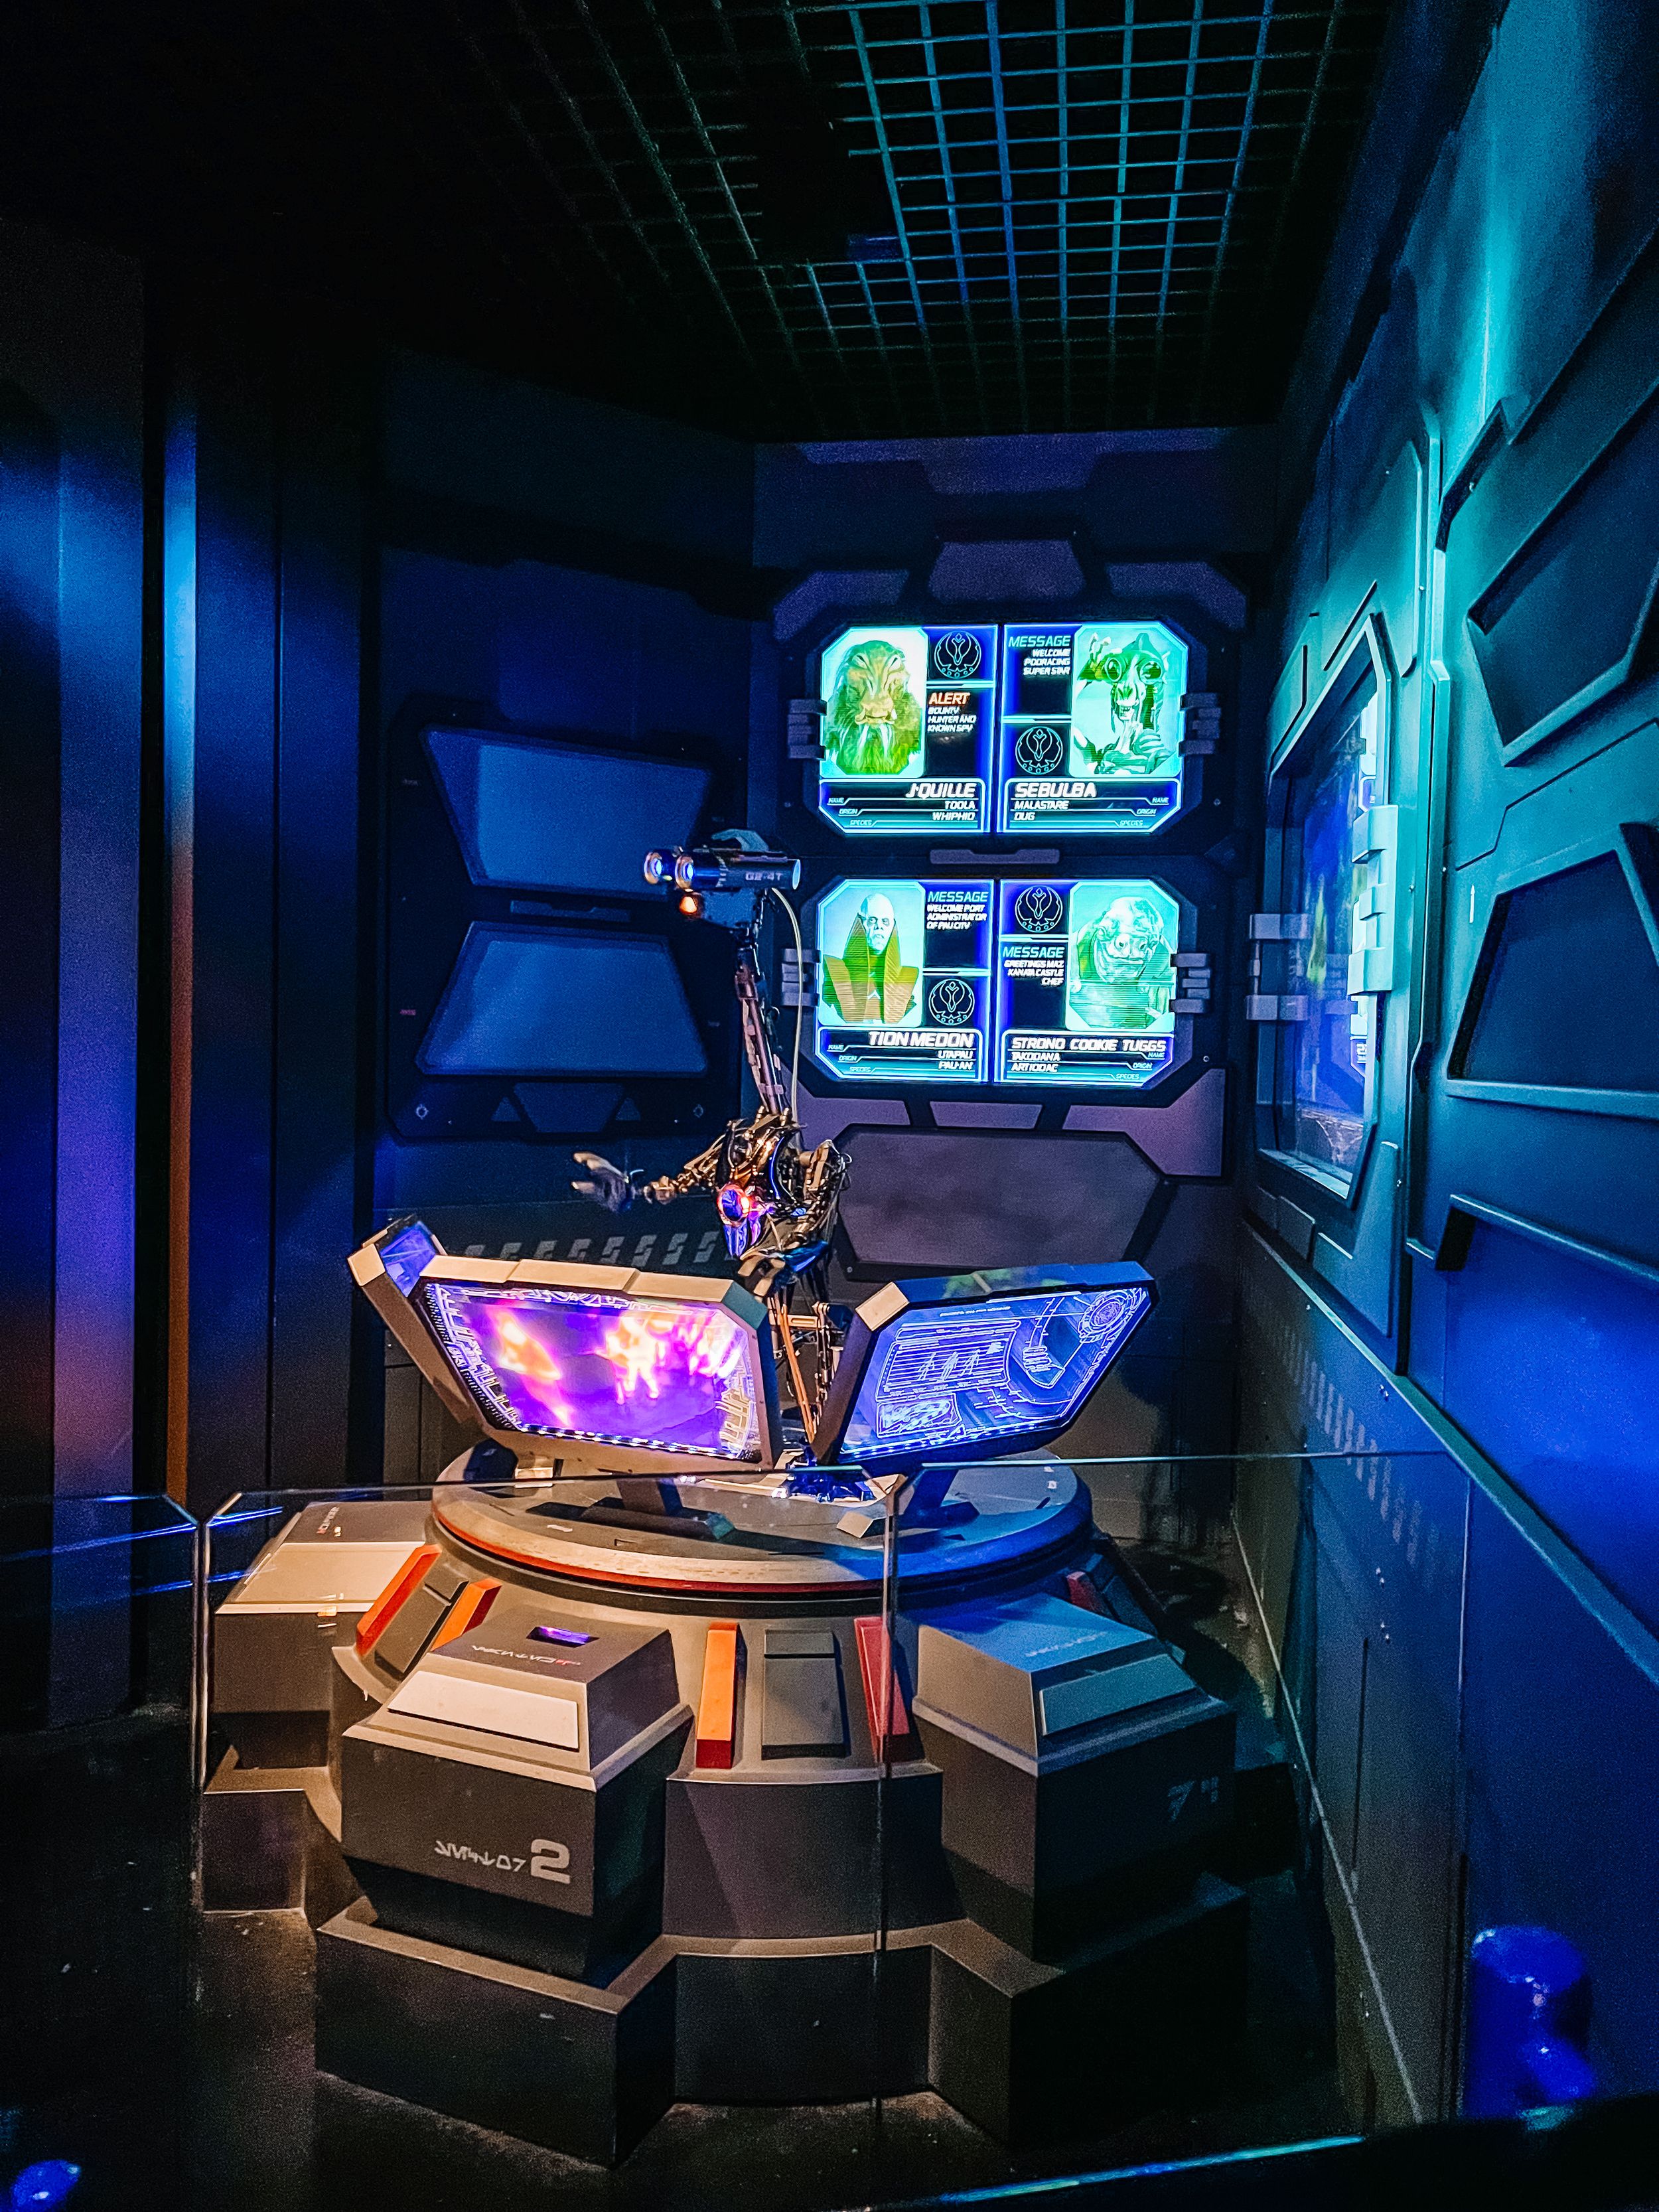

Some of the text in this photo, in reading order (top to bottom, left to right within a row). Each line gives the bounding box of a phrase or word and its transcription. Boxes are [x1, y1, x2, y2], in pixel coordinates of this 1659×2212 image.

[1009, 635, 1071, 647] MESSAGE
[1033, 648, 1071, 657] WELCOME
[1023, 666, 1070, 675] SUPER STAR
[929, 692, 970, 704] ALERT
[959, 715, 977, 723] AND
[1015, 782, 1097, 798] SEBULBA
[944, 800, 975, 810] TOOLA
[1014, 801, 1069, 810] MALASTARE
[1014, 812, 1035, 821] DUG
[928, 891, 989, 902] MESSAGE
[927, 903, 964, 912] WELCOME
[927, 913, 987, 921] ADMINISTRATOR
[1003, 946, 1065, 958] MESSAGE
[869, 1031, 974, 1048] TION MEDON
[1122, 1039, 1166, 1052] TUGGS
[938, 1050, 973, 1059] UTAPAU
[1011, 1051, 1061, 1061] TAKODANA
[1011, 1063, 1059, 1072] ARTIODAC
[530, 1838, 571, 1884] 2
